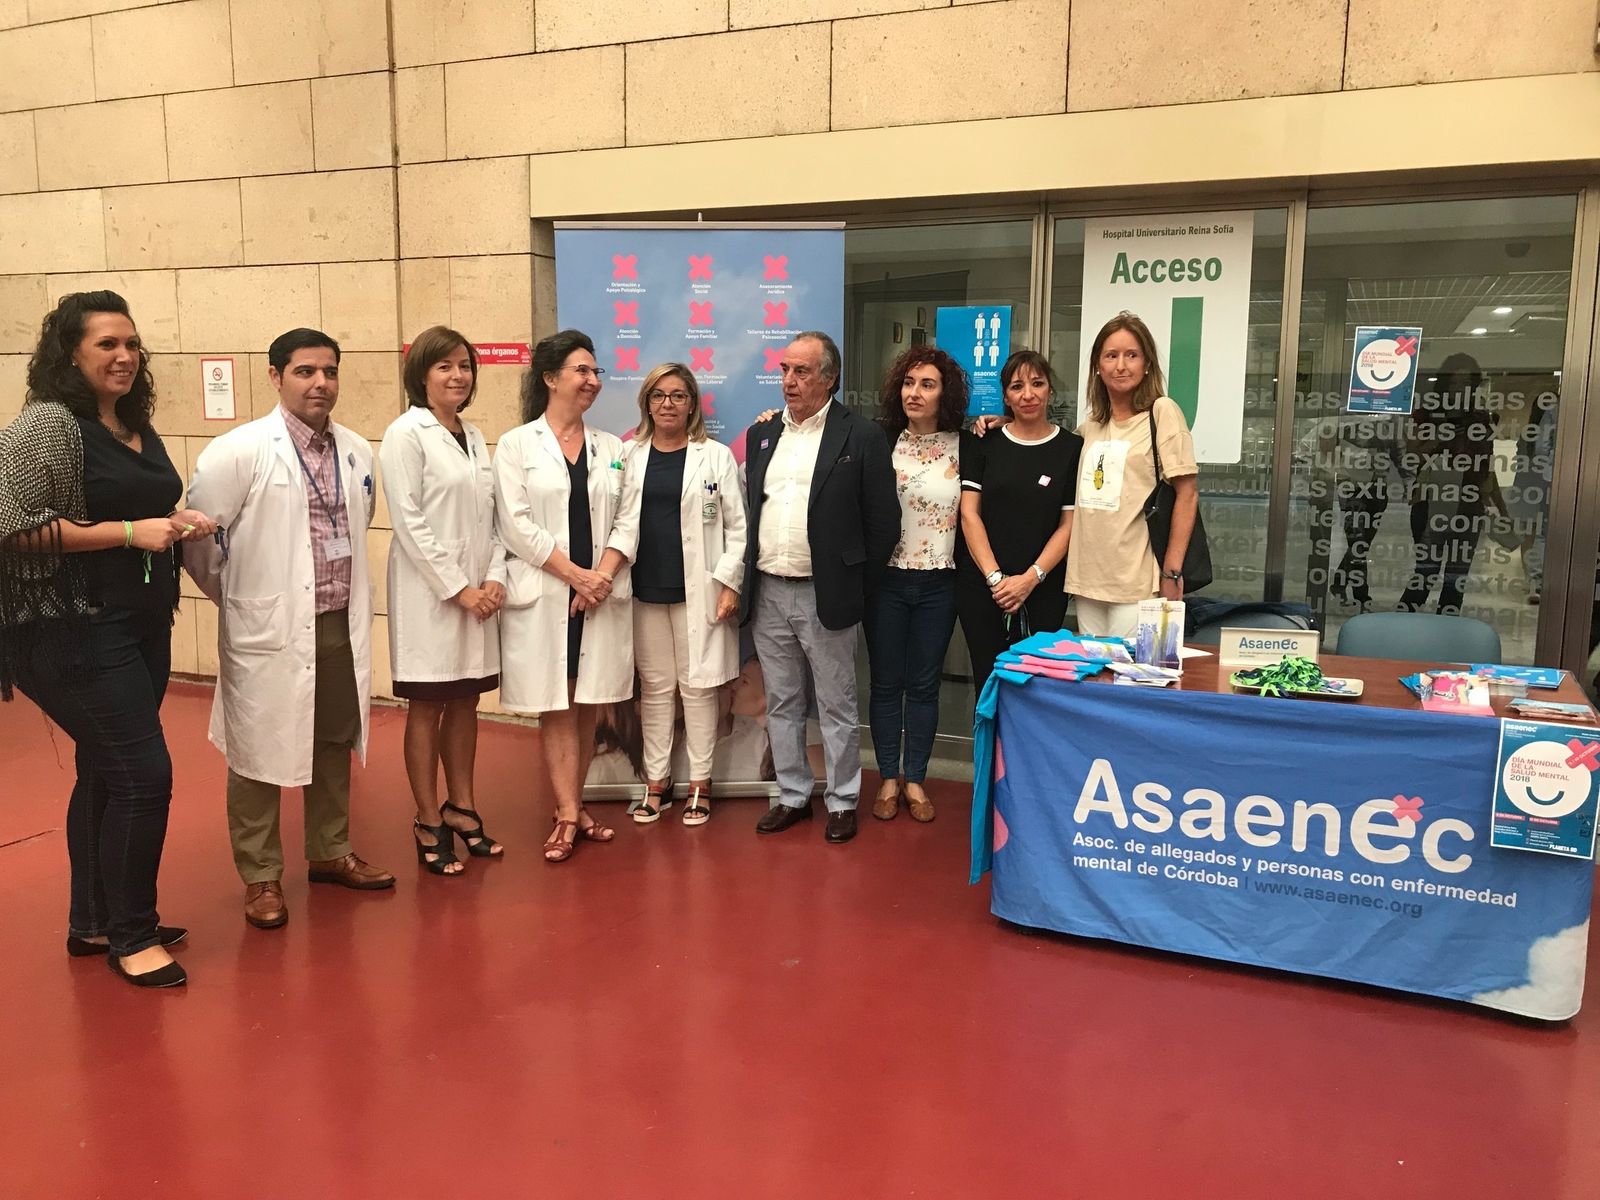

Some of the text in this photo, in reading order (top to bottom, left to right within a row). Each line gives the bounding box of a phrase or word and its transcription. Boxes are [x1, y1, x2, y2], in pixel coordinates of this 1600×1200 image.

[1103, 224, 1234, 239] Hospital Universitario Reina Sofía
[1110, 252, 1222, 284] Acceso
[491, 347, 519, 357] órganos
[1401, 448, 1552, 474] externas
[1337, 476, 1480, 503] externas
[1239, 636, 1298, 650] Asaenec
[1512, 756, 1525, 764] DÍA
[1527, 758, 1563, 769] MUNDIAL
[1510, 768, 1570, 781] SALUD MENTAL
[1510, 774, 1531, 783] 2018
[1073, 758, 1475, 873] Asaenec
[1073, 832, 1518, 908] Asoc. de allegados y personas con enfermedad
[1073, 855, 1423, 917] mental de Córdoba www.asaenec.org
